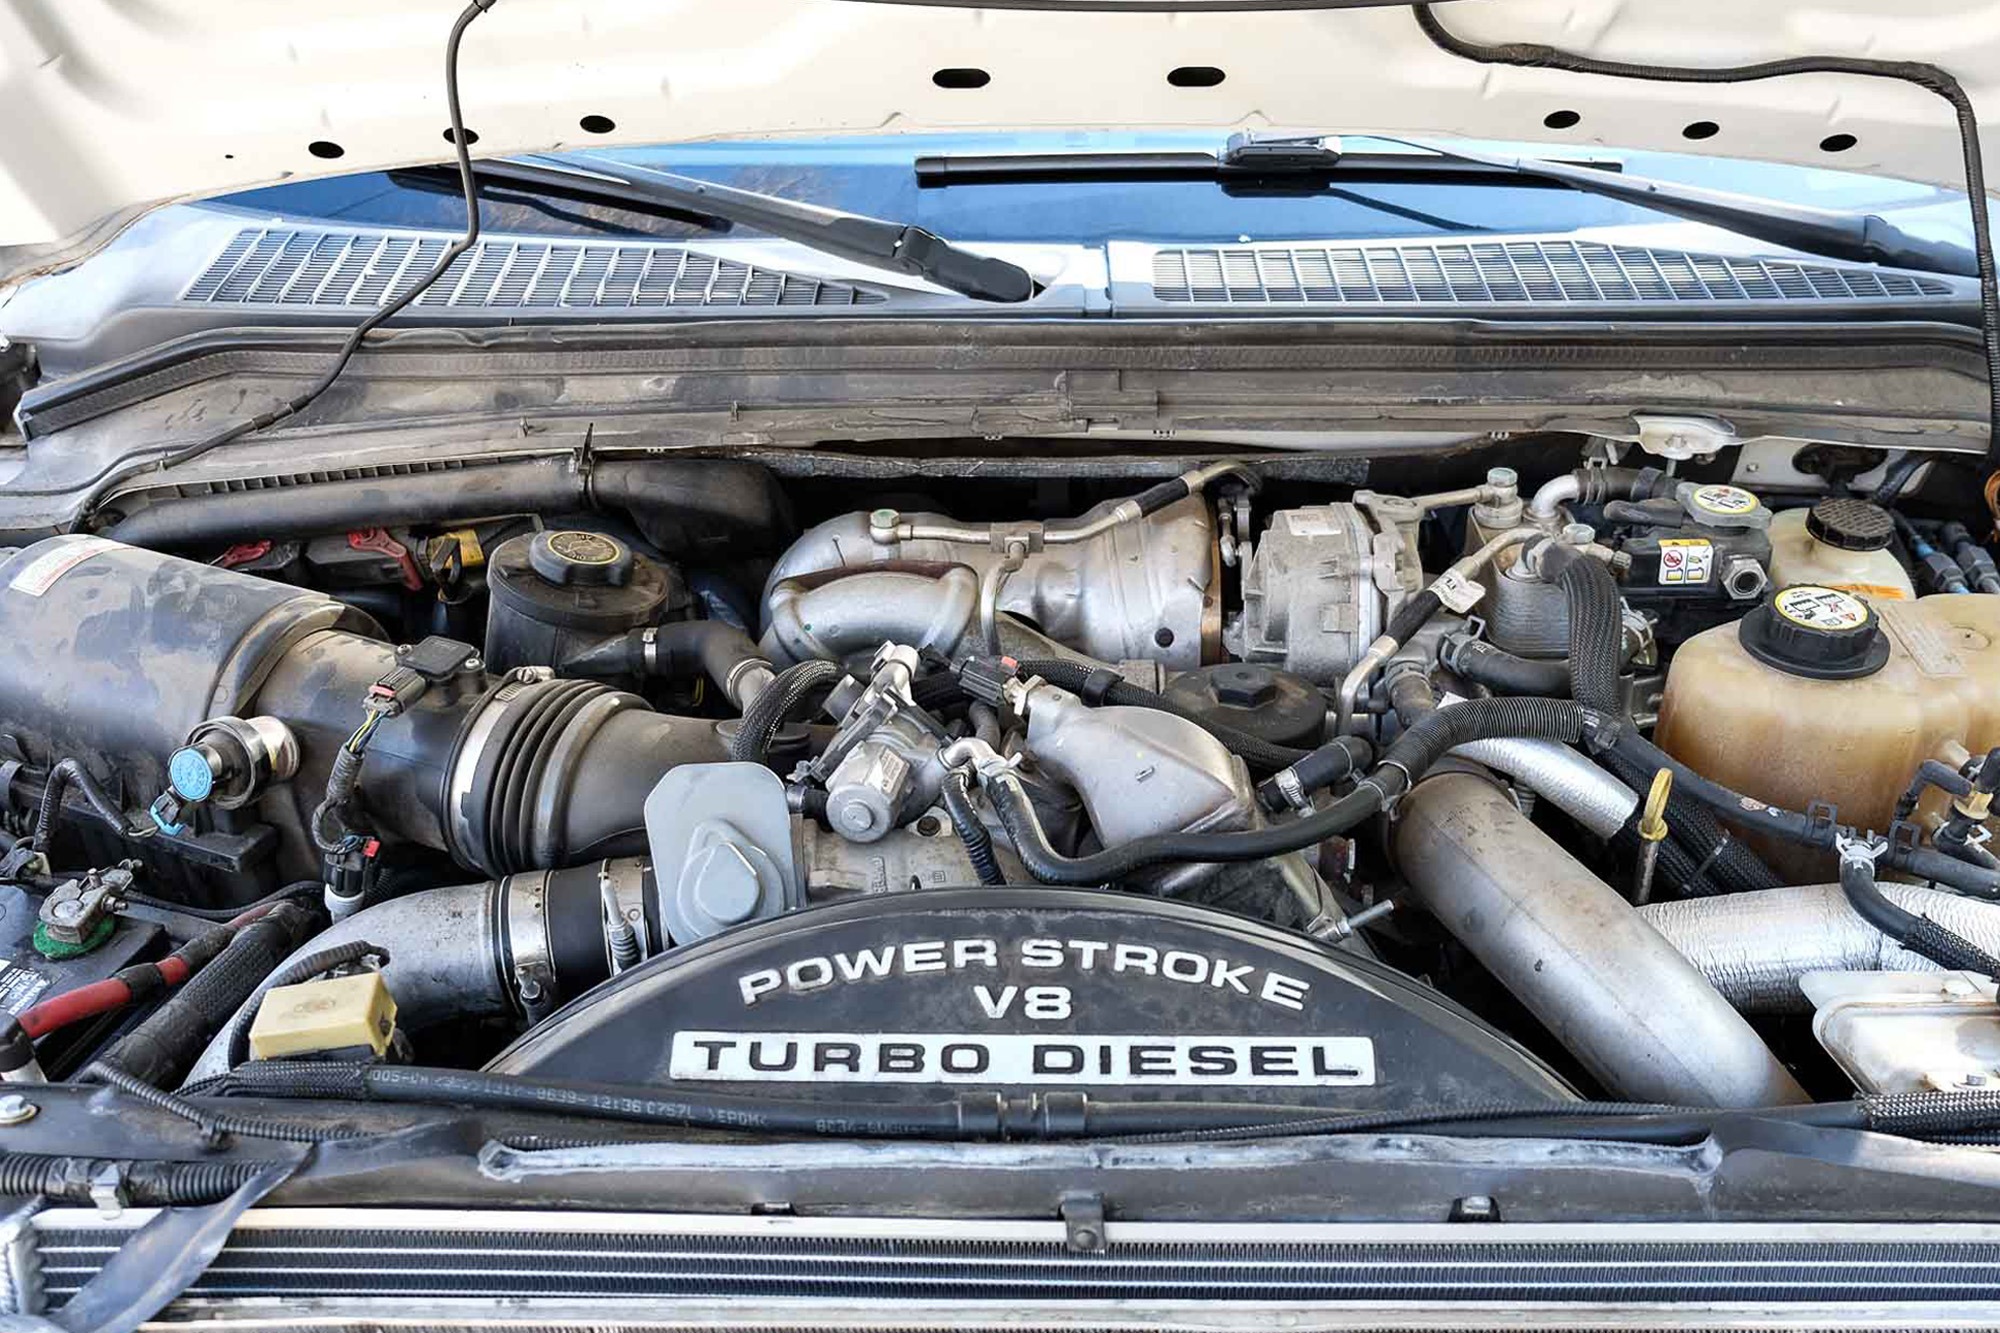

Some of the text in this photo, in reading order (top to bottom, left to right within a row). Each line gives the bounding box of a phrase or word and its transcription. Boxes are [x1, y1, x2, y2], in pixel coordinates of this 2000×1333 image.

[738, 938, 1311, 1011] POWER STROKE
[973, 985, 1072, 1019] V8
[693, 1041, 1359, 1077] TURBO DIESEL
